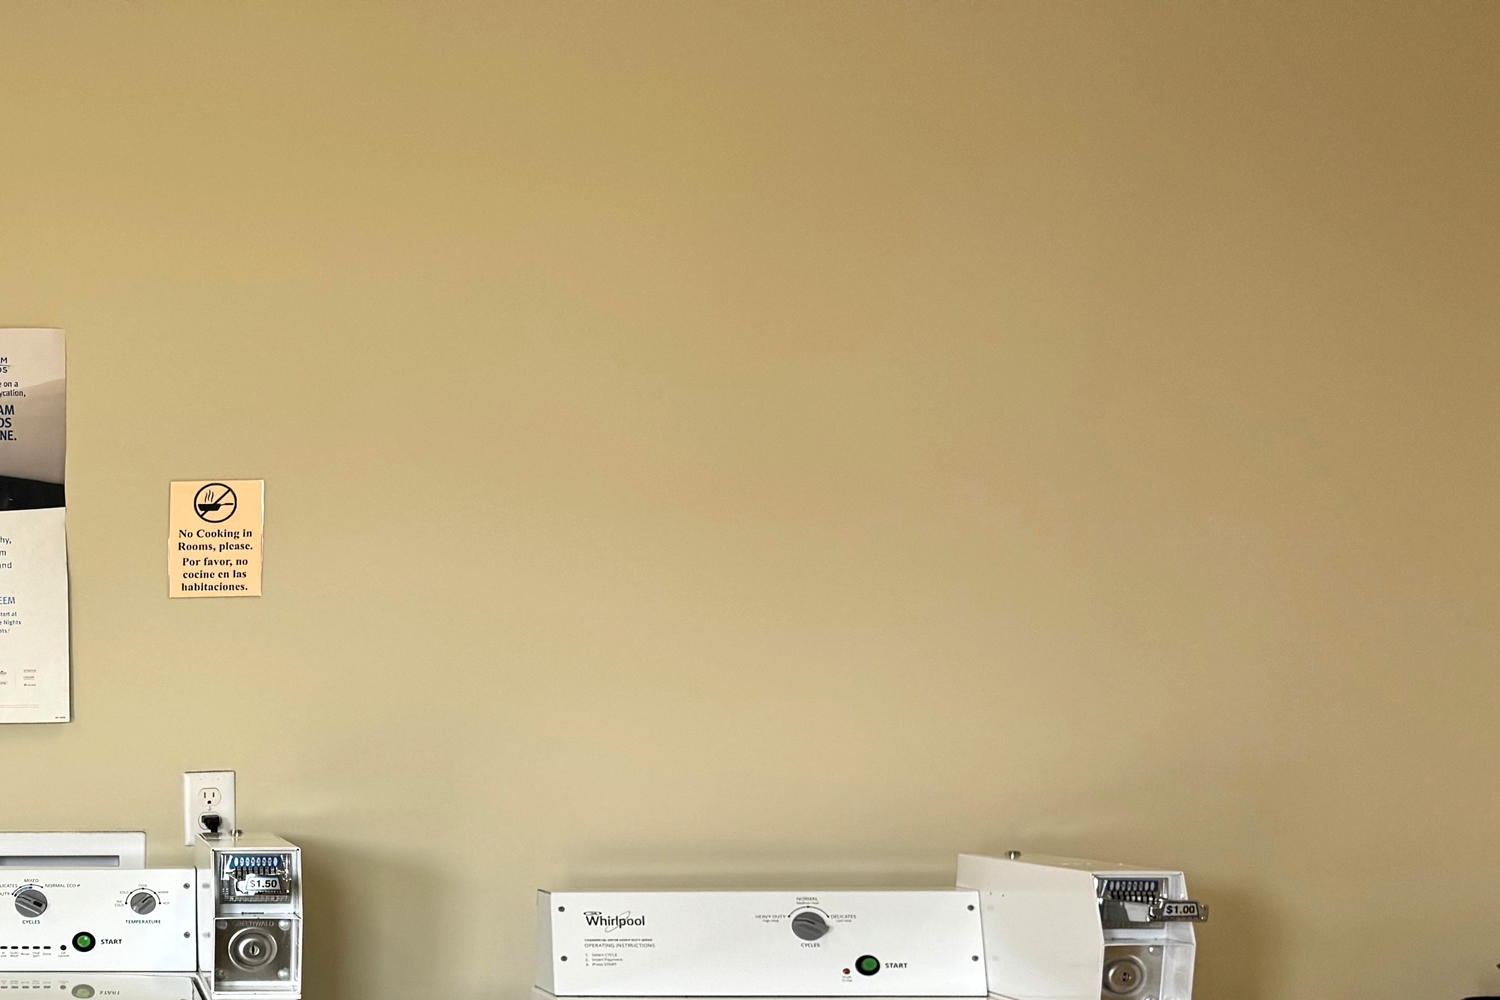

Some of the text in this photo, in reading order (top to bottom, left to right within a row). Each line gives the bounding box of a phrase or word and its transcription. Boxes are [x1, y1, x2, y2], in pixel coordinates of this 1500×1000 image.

[179, 529, 252, 540] No Cooking in
[178, 542, 253, 552] Rooms, please.
[183, 558, 201, 566] Por
[203, 557, 232, 567] favor,
[183, 570, 215, 578] cocine
[233, 570, 247, 578] las
[181, 582, 248, 591] habitaciones.
[1166, 905, 1195, 914] $1.00
[586, 916, 645, 929] Whirlpool
